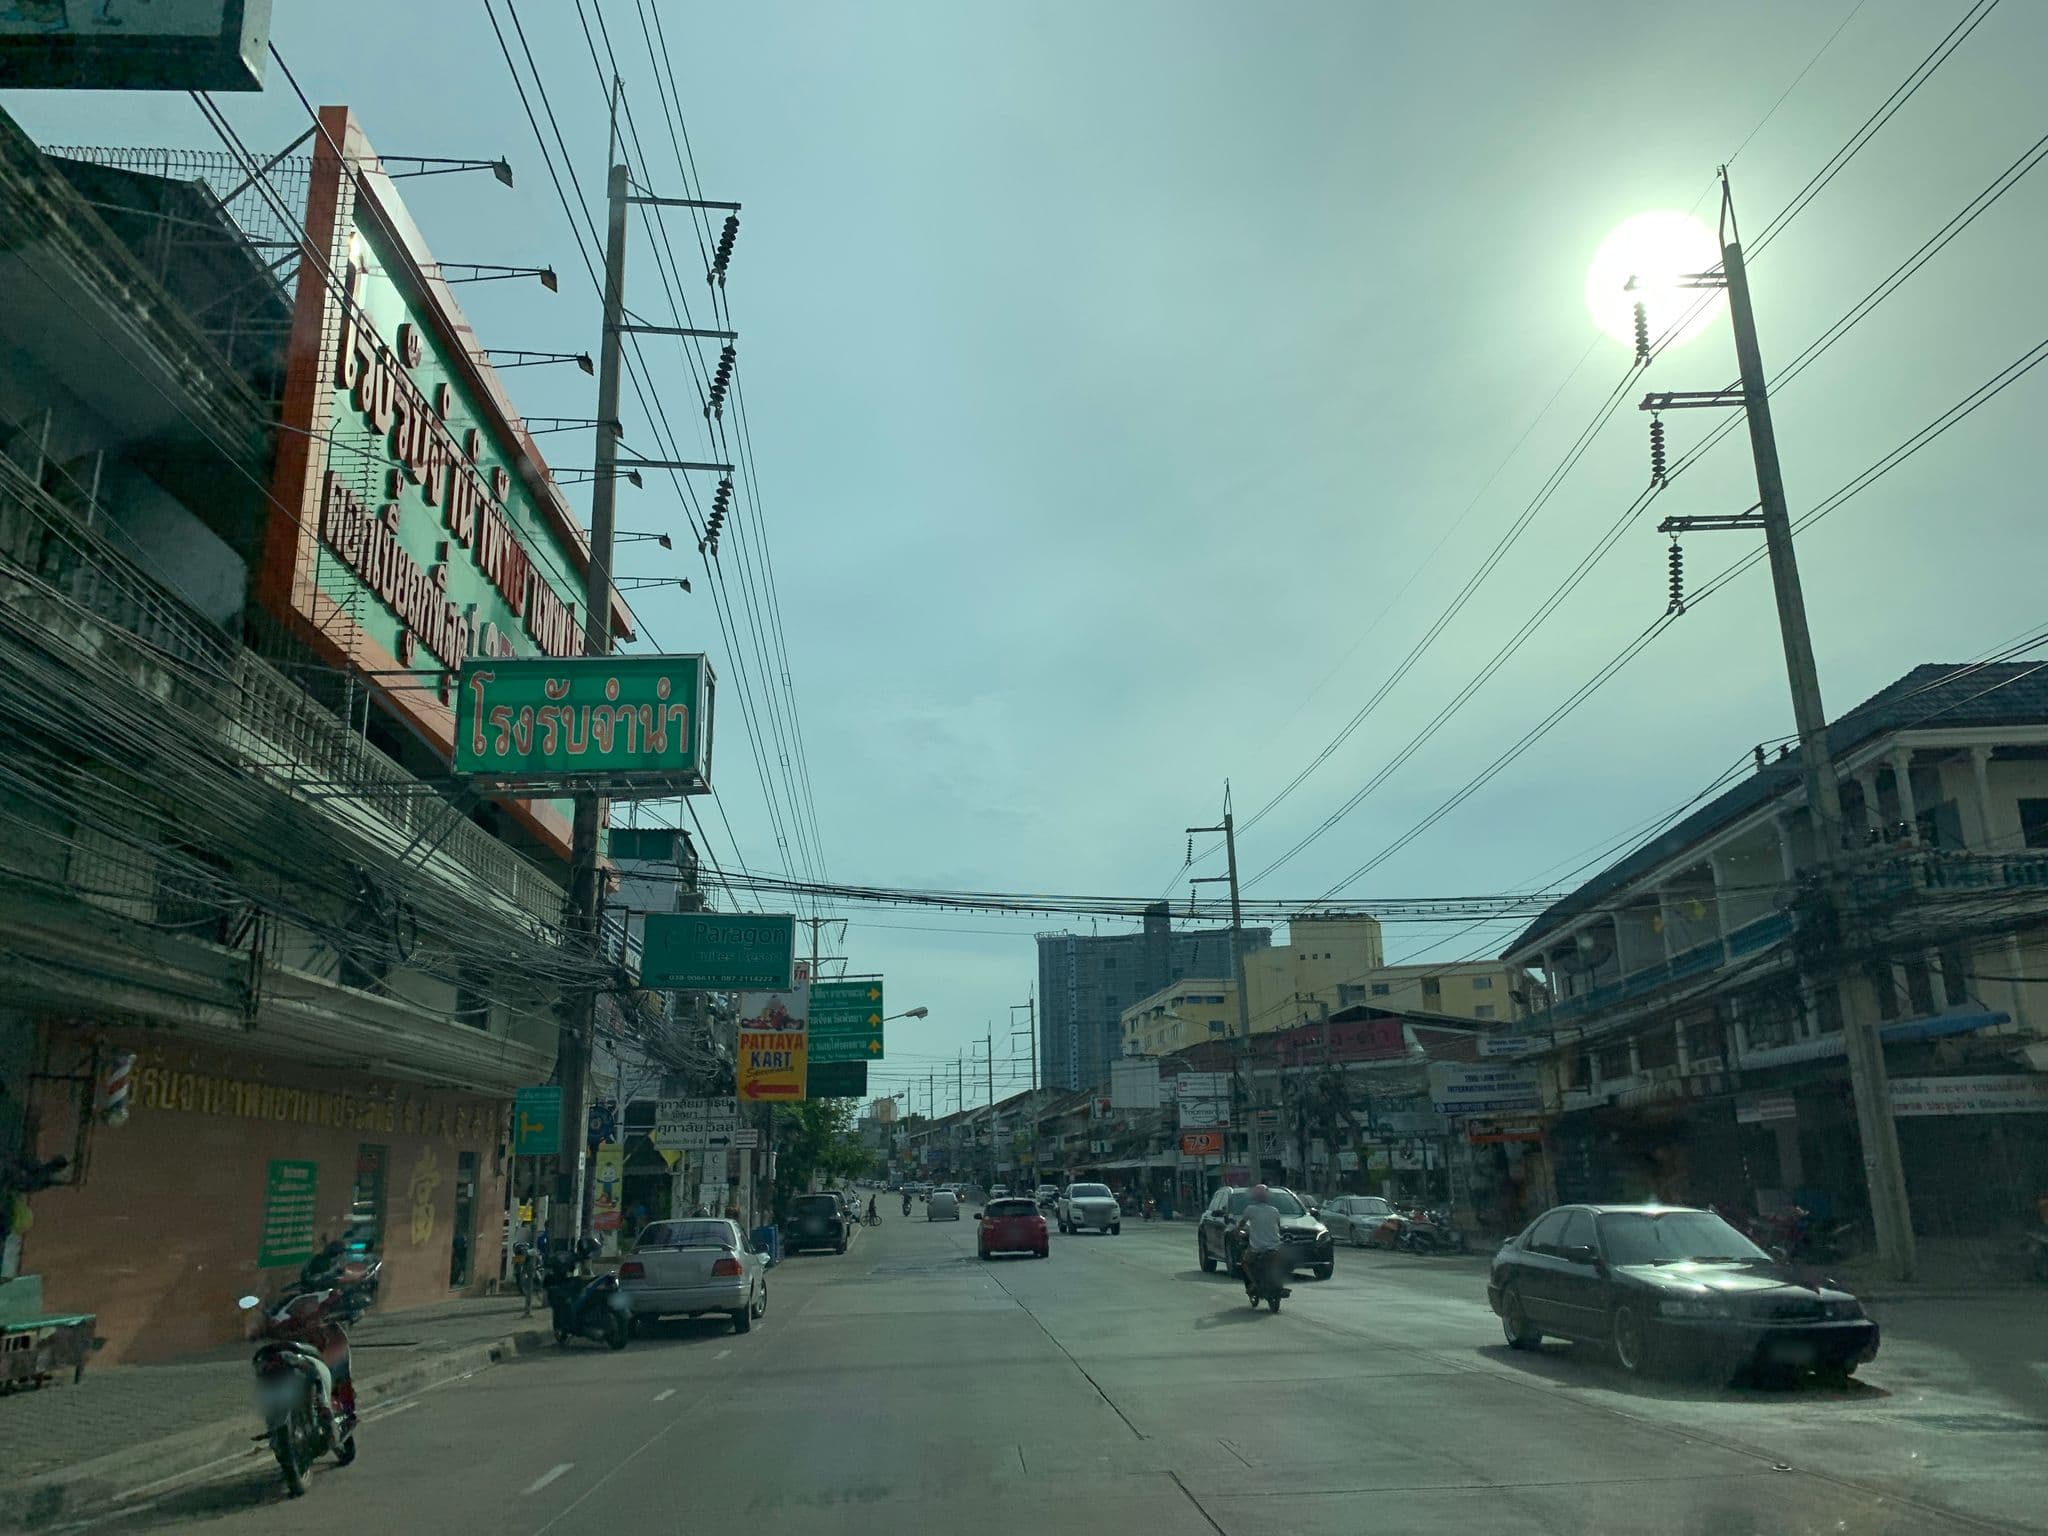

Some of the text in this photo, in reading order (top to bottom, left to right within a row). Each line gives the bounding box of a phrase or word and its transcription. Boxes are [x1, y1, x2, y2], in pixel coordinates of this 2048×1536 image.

[470, 671, 689, 756] โรงรับจำนำ
[694, 921, 787, 950] Paragon
[740, 1034, 805, 1051] PATTAYA
[751, 1052, 792, 1068] KART
